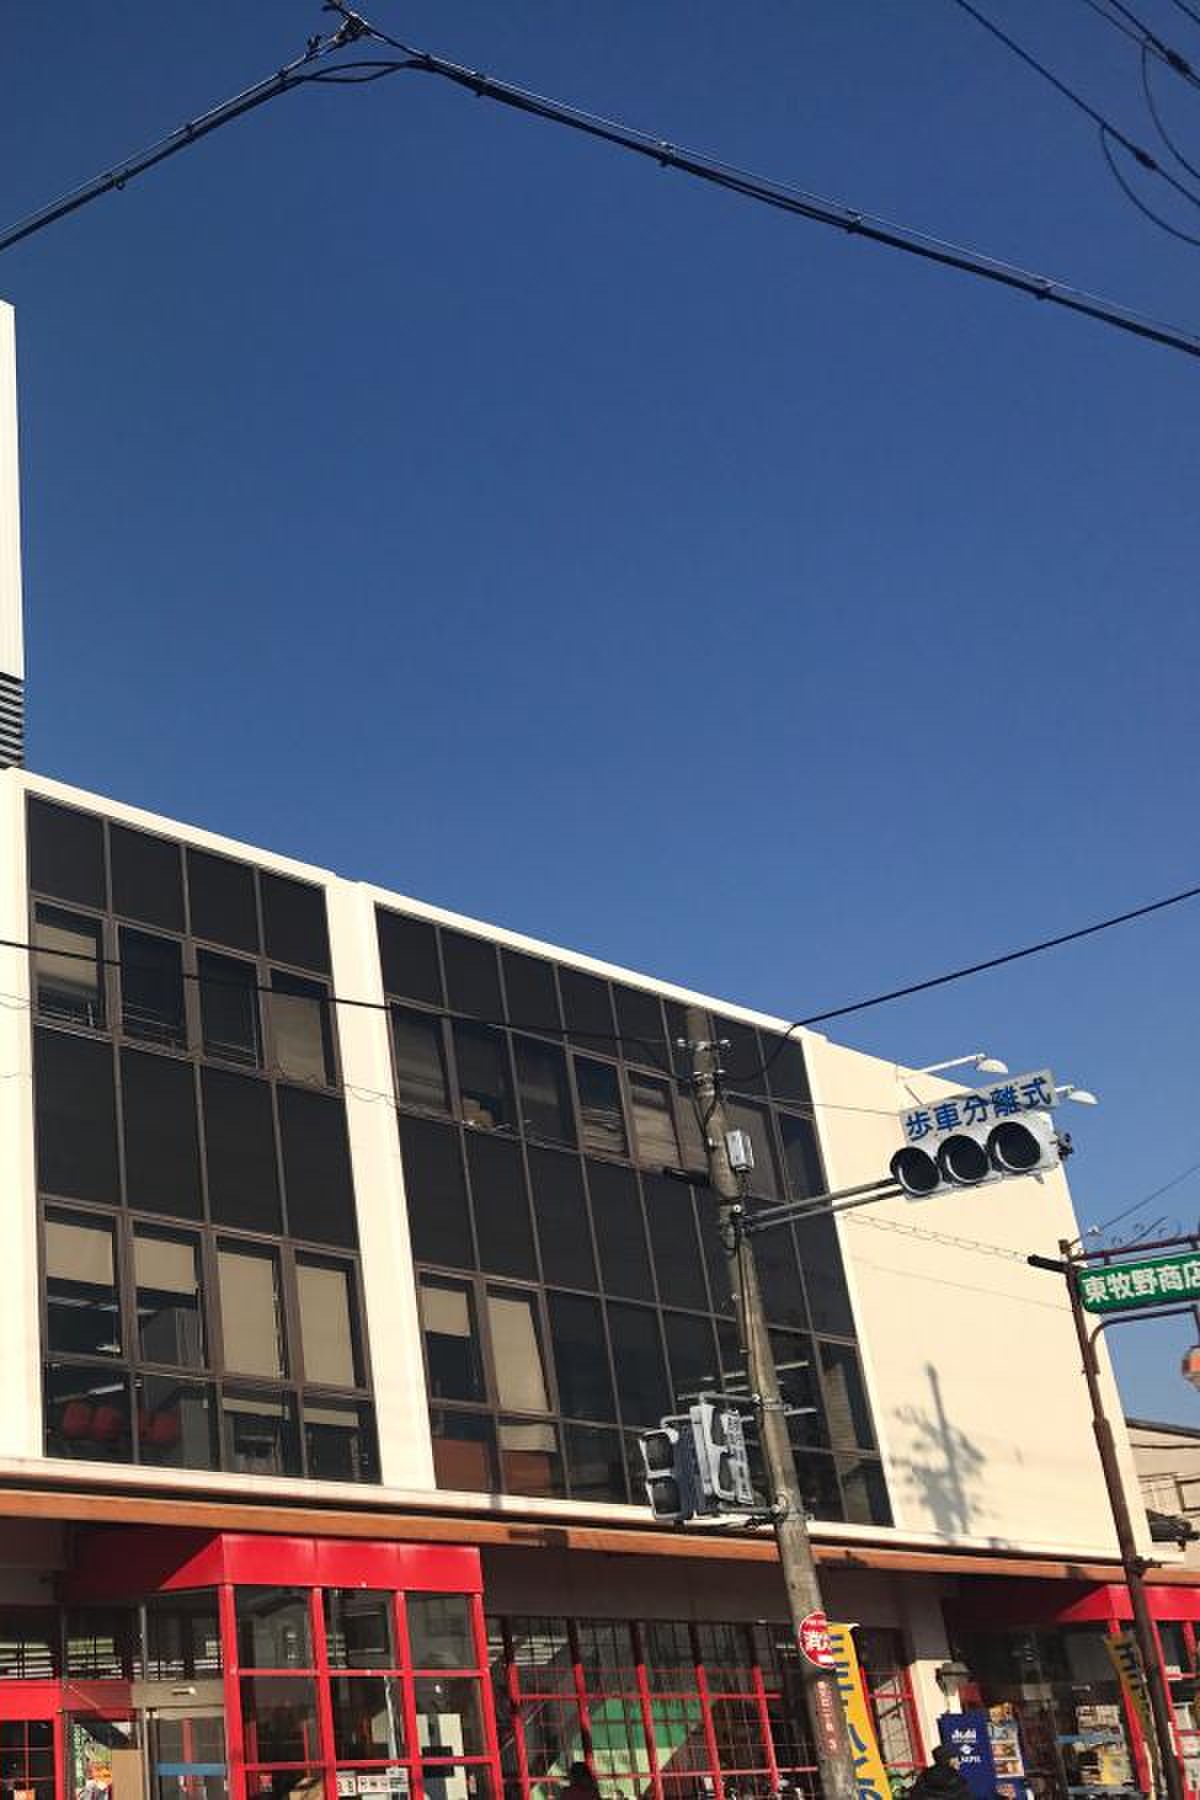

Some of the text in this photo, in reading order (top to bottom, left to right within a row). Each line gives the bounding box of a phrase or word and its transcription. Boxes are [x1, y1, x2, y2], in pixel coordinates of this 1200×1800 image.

[905, 1078, 1052, 1141] 歩車分離式
